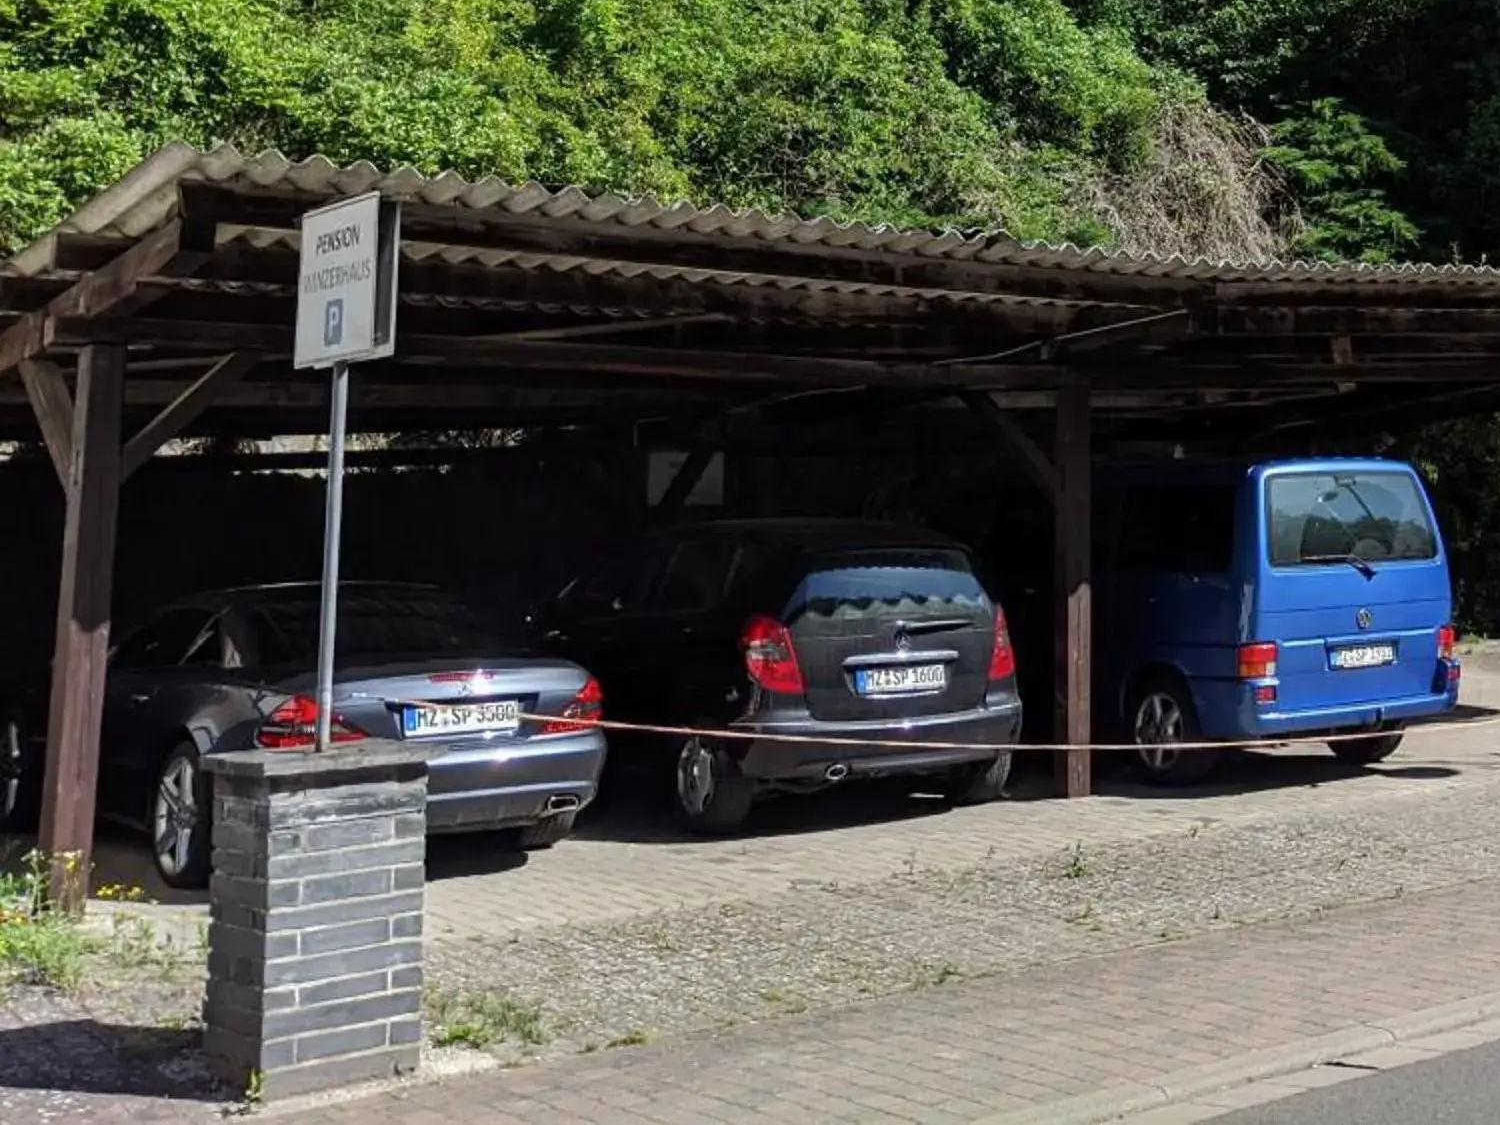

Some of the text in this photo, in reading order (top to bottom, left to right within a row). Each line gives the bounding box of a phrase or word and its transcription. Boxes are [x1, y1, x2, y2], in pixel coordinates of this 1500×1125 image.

[315, 224, 362, 254] PENSION
[304, 259, 372, 292] WINZERHAUS
[417, 708, 439, 727] MZ
[451, 707, 471, 725] SP
